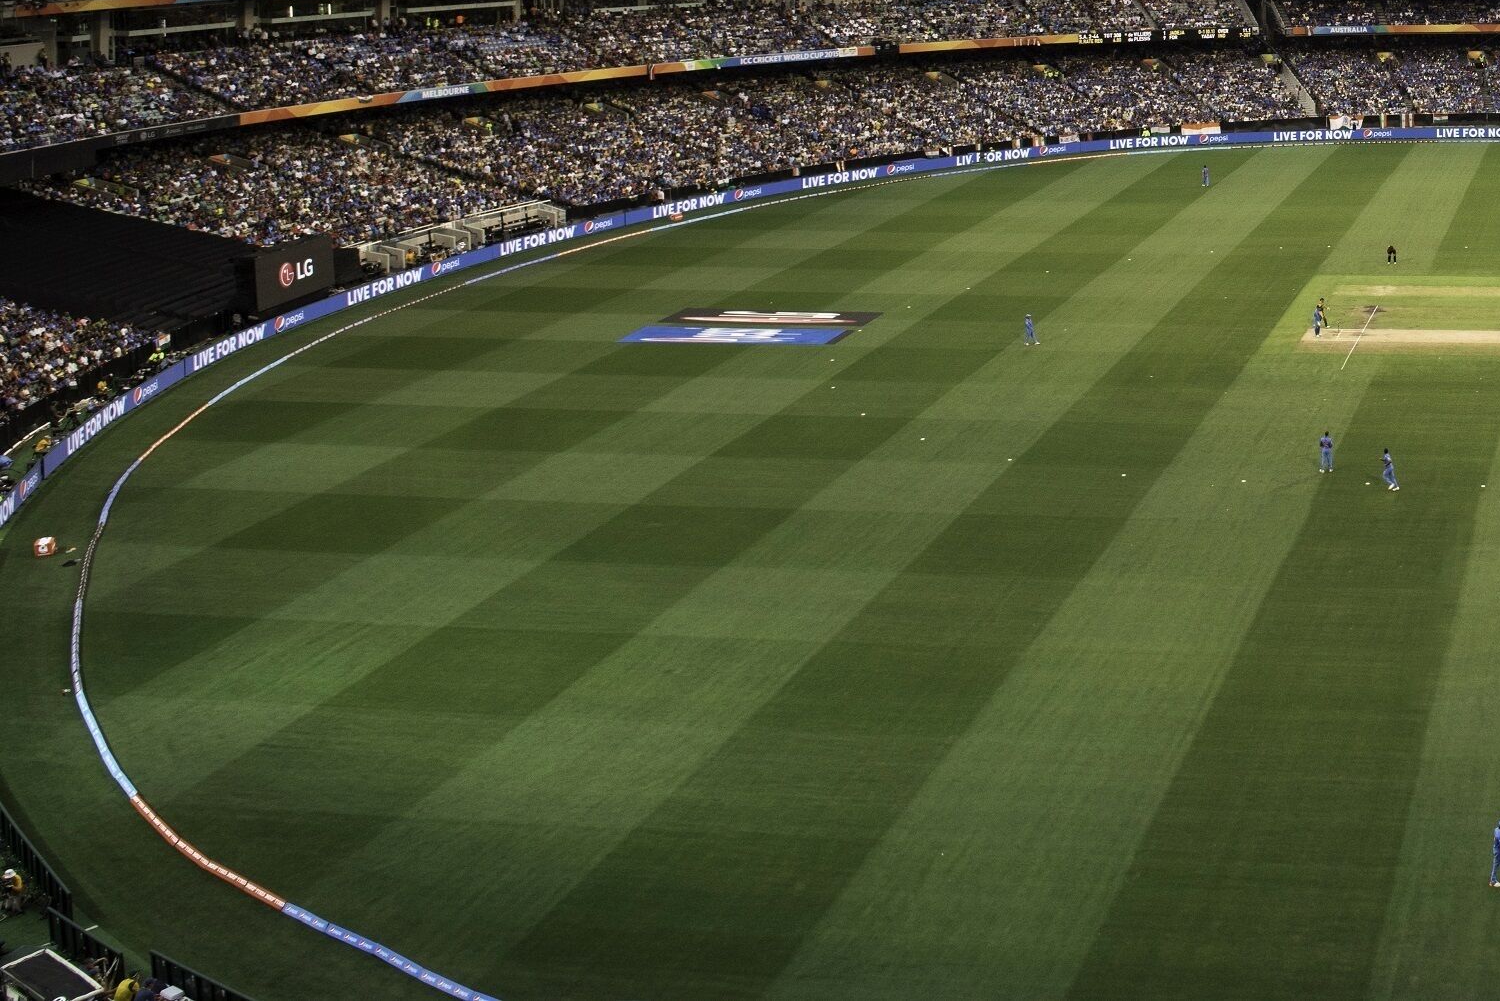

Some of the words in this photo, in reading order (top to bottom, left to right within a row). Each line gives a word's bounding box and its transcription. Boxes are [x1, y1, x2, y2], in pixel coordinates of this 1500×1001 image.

[422, 86, 469, 98] MELBOURNE
[1274, 131, 1297, 141] LIVE
[1300, 131, 1322, 140] FOR
[1325, 130, 1352, 140] NOW
[1436, 128, 1460, 137] LIVE
[1462, 128, 1485, 137] FOR
[1110, 139, 1133, 149] LIVE
[1136, 137, 1158, 147] FOR
[1161, 136, 1189, 146] NOW
[1210, 135, 1228, 144] pepsi
[1004, 148, 1030, 160] NOW
[1048, 145, 1066, 154] pepsi
[896, 163, 915, 173] pepsi
[802, 174, 825, 188] LIVE
[828, 171, 849, 184] FOR
[852, 167, 878, 181] NOW
[744, 188, 761, 197] pepsi
[653, 204, 674, 218] LIVE
[677, 199, 697, 213] FOR
[700, 193, 725, 208] NOW
[594, 219, 612, 230] pepsi
[500, 239, 522, 256] LIVE
[524, 233, 546, 249] FOR
[548, 225, 575, 243] NOW
[296, 258, 314, 280] LG
[442, 258, 460, 272] pepsi
[347, 286, 370, 306] LIVE
[372, 278, 394, 296] FOR
[396, 268, 423, 288] NOW
[286, 311, 304, 327] pepsi
[193, 346, 215, 370] LIVE
[216, 337, 236, 359] FOR
[238, 324, 265, 348] NOW
[67, 426, 84, 455] LIVE
[85, 415, 101, 440] FOR
[102, 397, 126, 426] NOW
